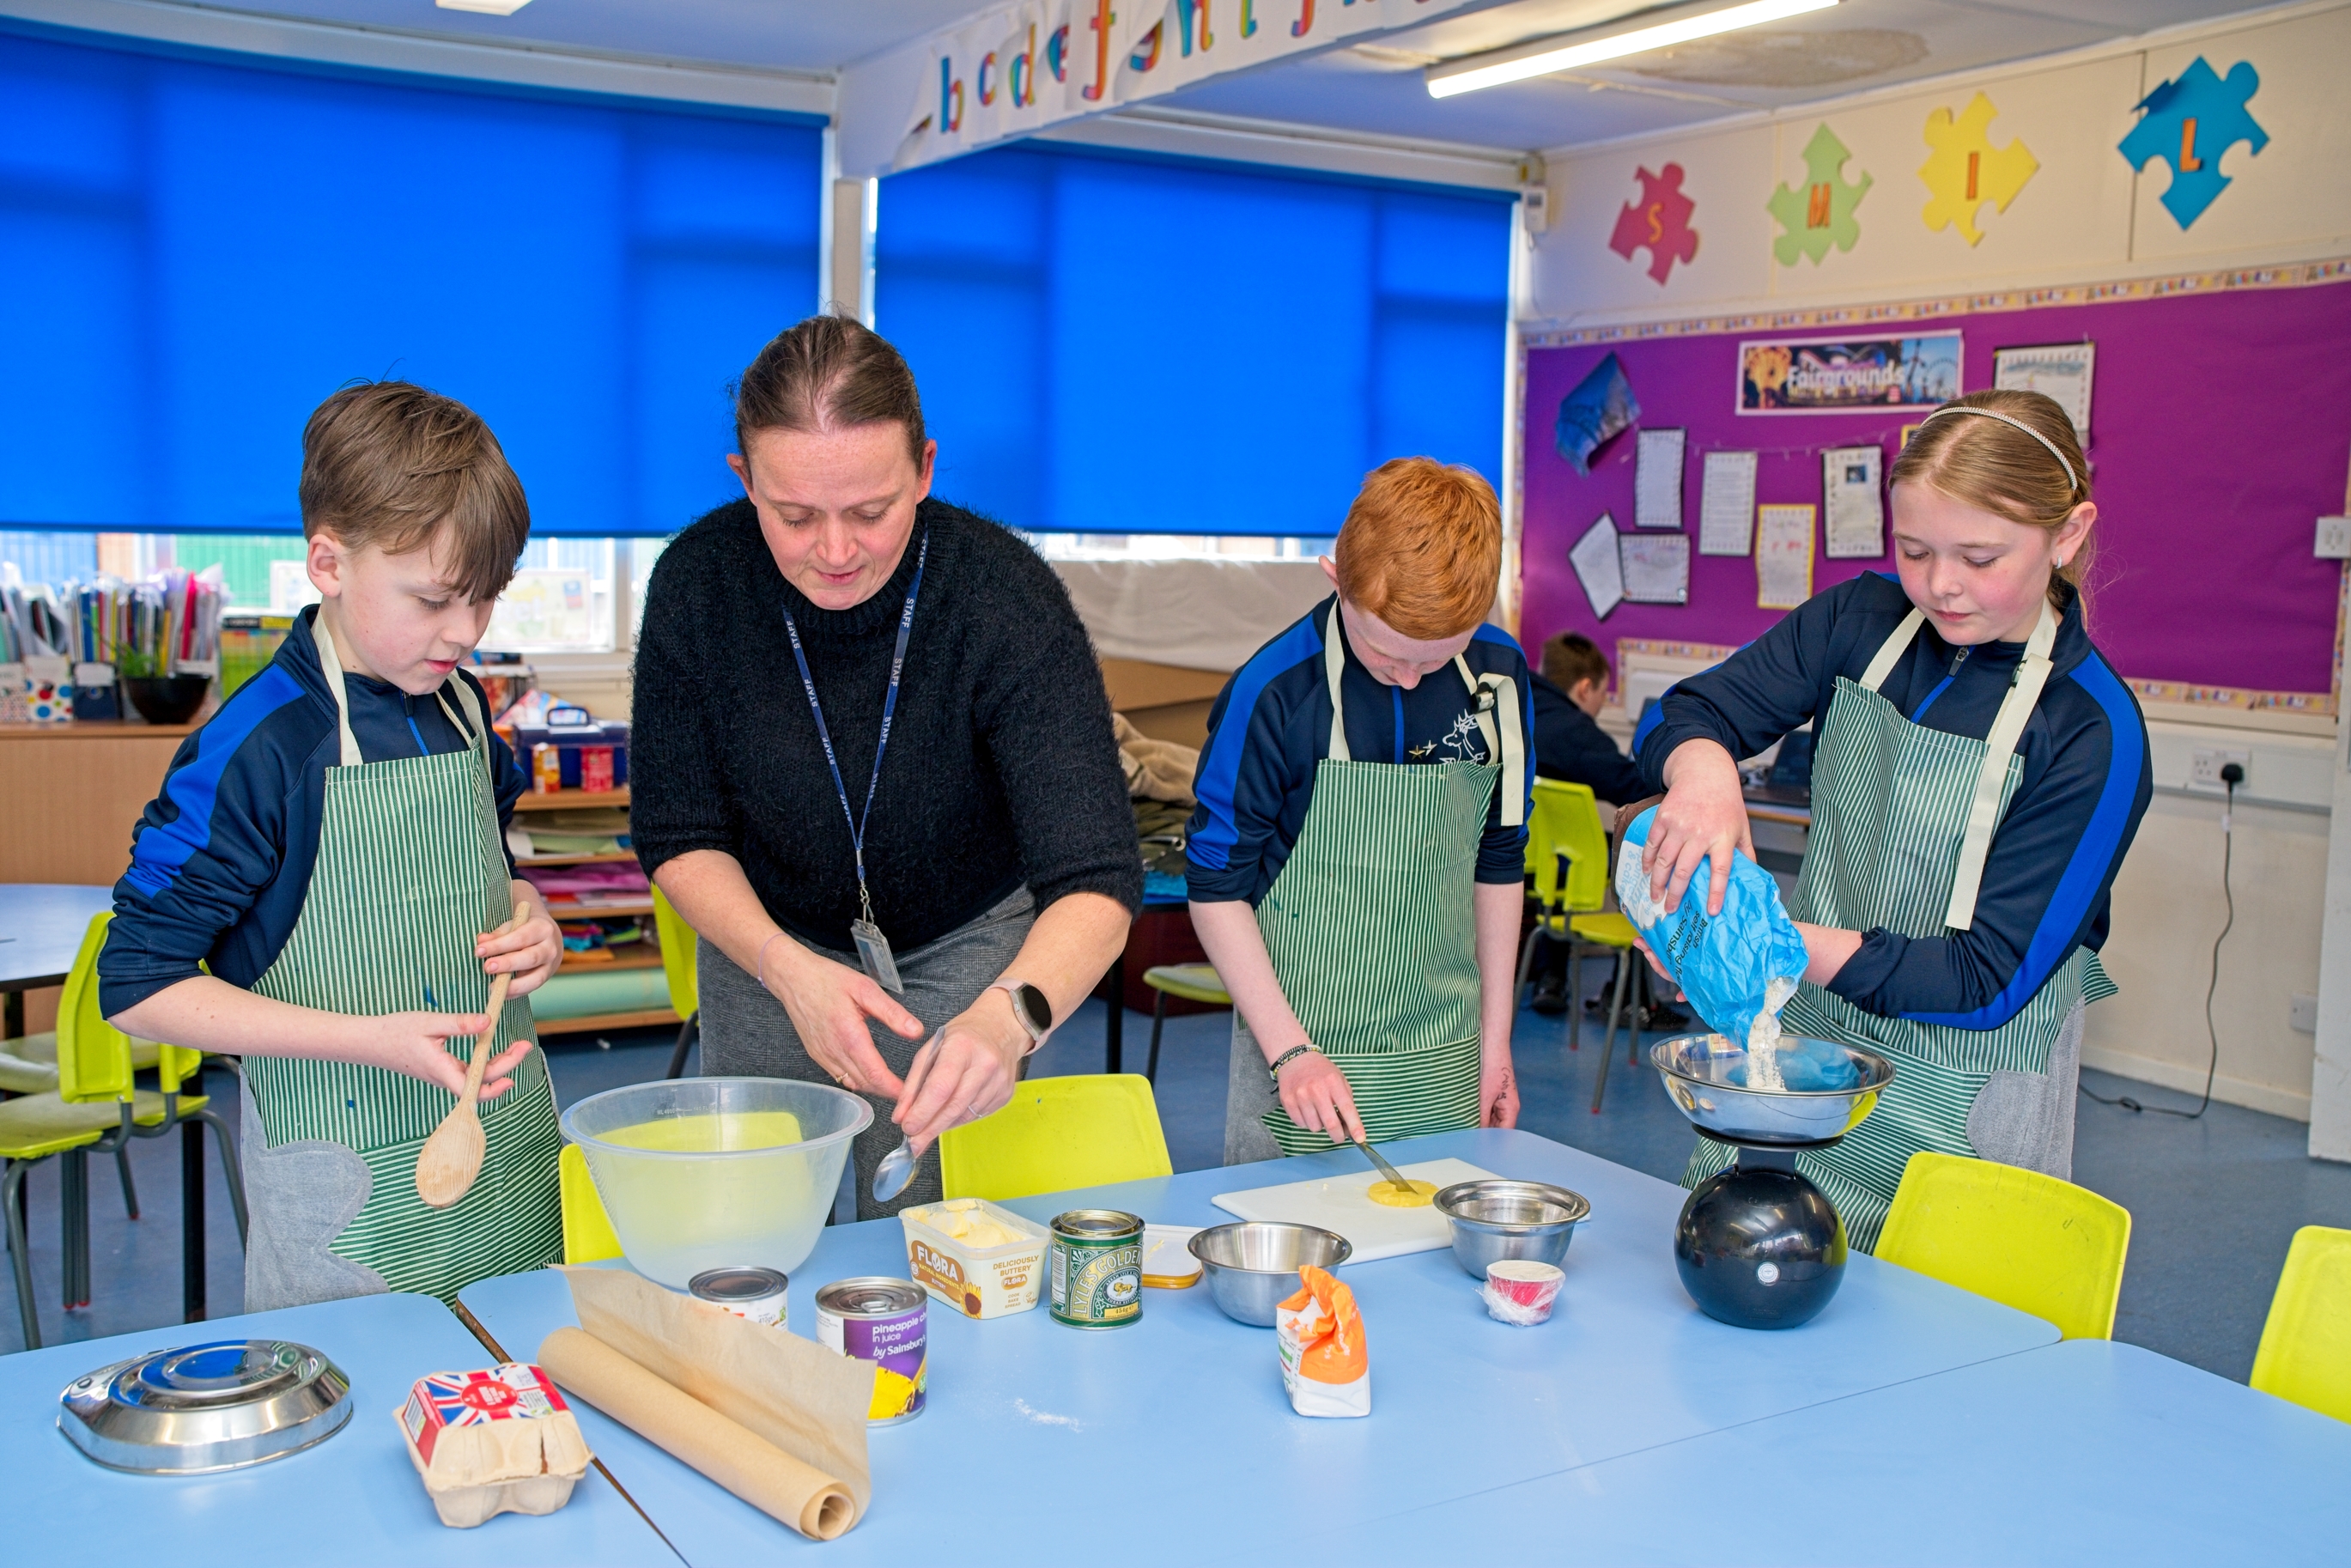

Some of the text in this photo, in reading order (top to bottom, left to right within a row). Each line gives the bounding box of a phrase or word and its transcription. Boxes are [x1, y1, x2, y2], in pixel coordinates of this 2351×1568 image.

[940, 55, 965, 133] b
[978, 52, 997, 106] c
[1010, 22, 1036, 108] d
[1648, 202, 1664, 243] S
[1807, 182, 1831, 228] M
[2179, 118, 2202, 172] L
[1786, 358, 1905, 396] Fairgrounds
[902, 598, 914, 629] STAFF
[787, 620, 800, 649] STAFF
[890, 658, 902, 687] STAFF
[804, 678, 818, 707] STAFF
[881, 716, 891, 744] STAFF
[822, 737, 835, 765] STAFF
[1619, 862, 1632, 898] cakes
[1684, 899, 1693, 917] by
[1691, 910, 1701, 933] self
[1674, 930, 1693, 965] raising
[917, 1245, 959, 1282] FLORA
[993, 1255, 1040, 1271] DELICIOUSLY
[999, 1264, 1032, 1277] BUTTERY
[1096, 1249, 1142, 1274] GOLDEN
[919, 1262, 936, 1277] NATURAL
[935, 1272, 960, 1290] INGREDIENTS
[931, 1277, 947, 1290] BUTTERY
[1004, 1275, 1027, 1286] FLORA
[1115, 1306, 1128, 1315] 454g
[872, 1316, 919, 1336] pineapple
[872, 1332, 902, 1344] in juice
[872, 1334, 926, 1359] by Sainsbury's
